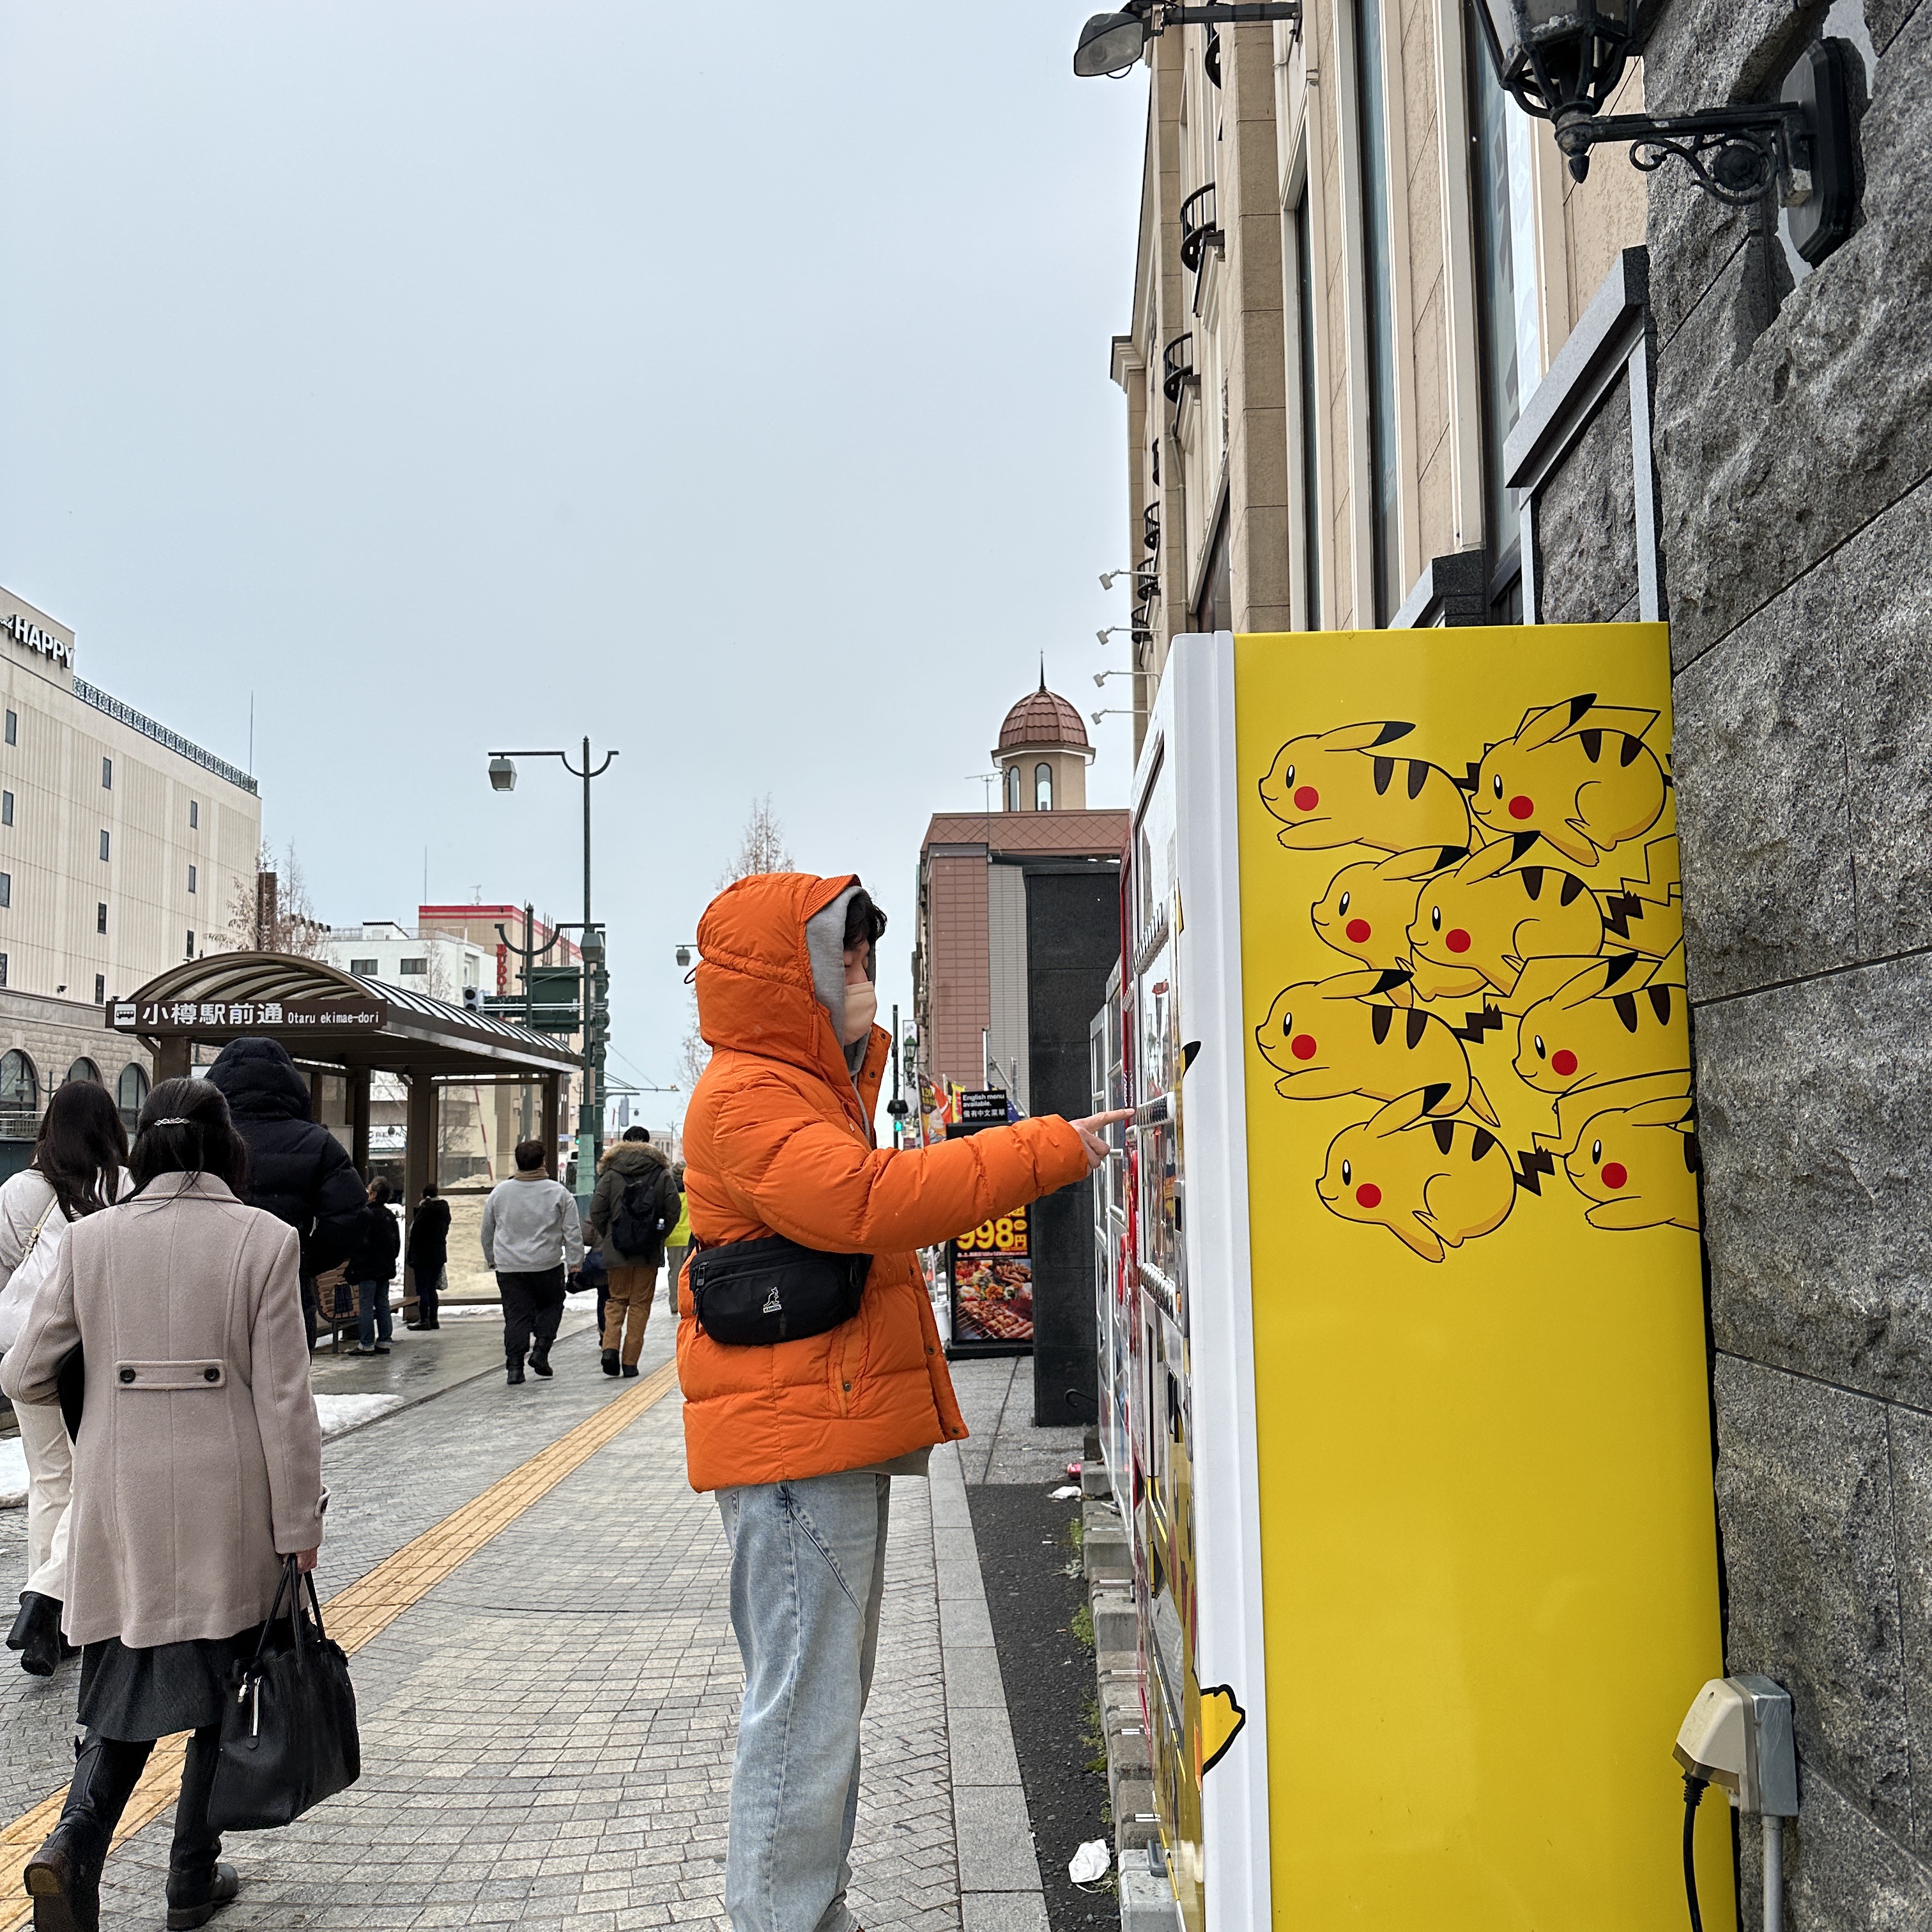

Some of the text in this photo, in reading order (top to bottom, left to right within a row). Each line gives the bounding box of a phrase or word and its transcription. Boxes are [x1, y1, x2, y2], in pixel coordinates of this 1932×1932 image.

[14, 615, 75, 668] HAPPY
[142, 1002, 283, 1025] 小樽駅前通
[288, 1011, 379, 1023] Otaru ekimae-dori
